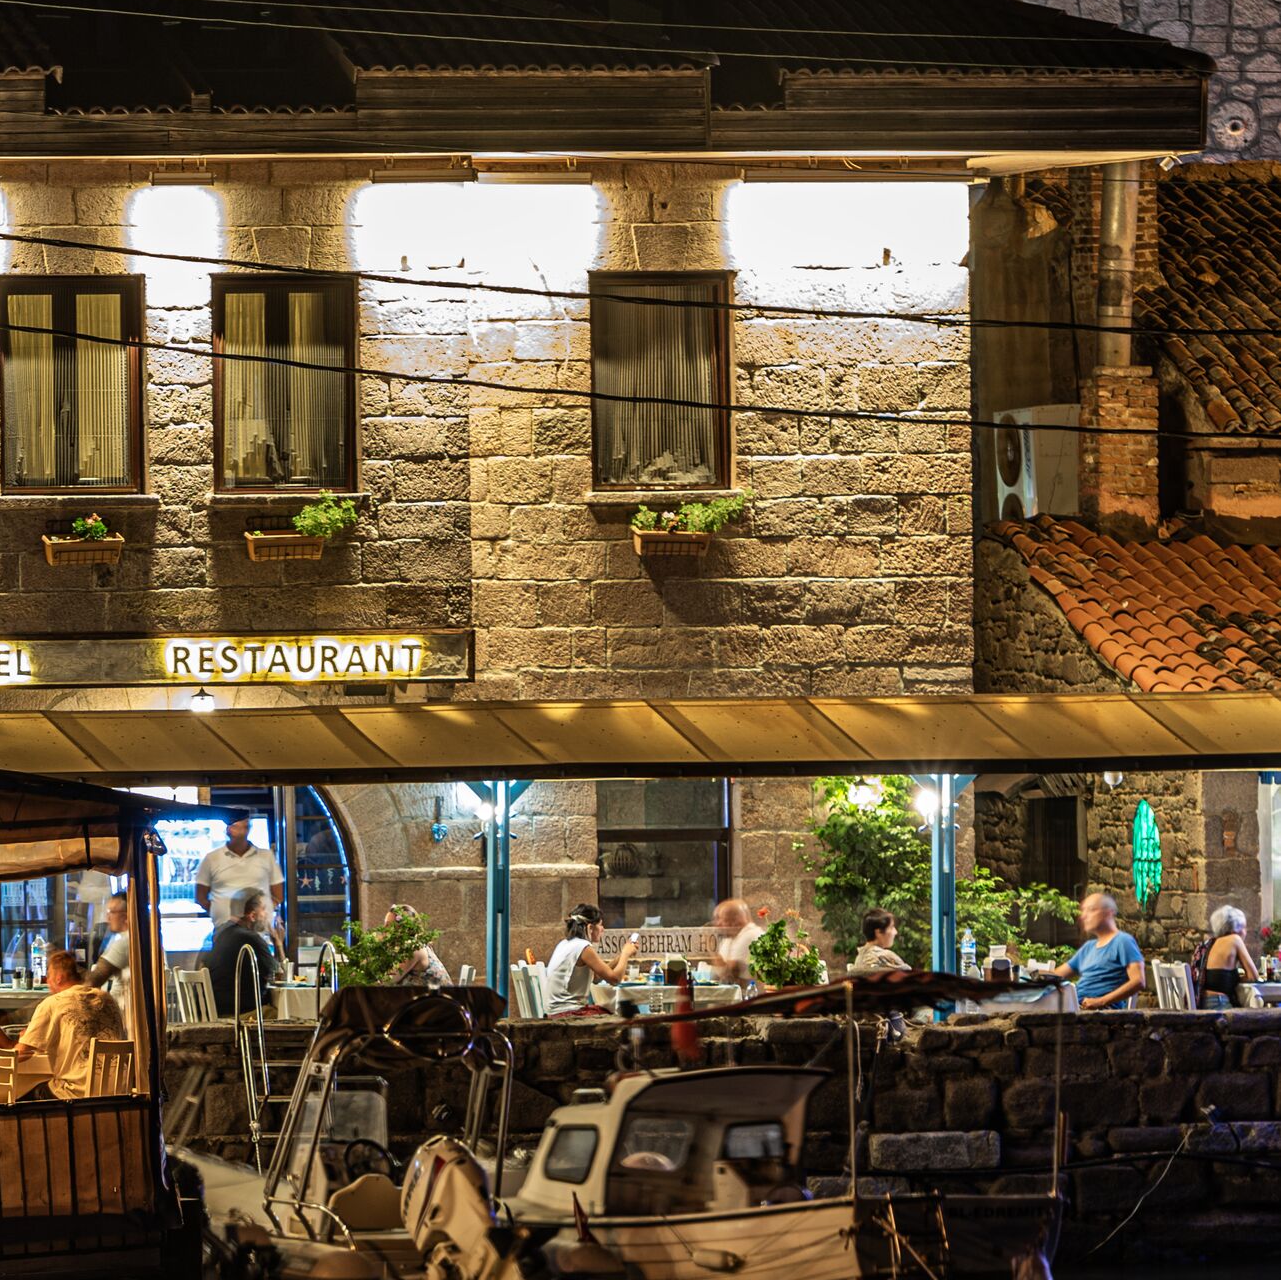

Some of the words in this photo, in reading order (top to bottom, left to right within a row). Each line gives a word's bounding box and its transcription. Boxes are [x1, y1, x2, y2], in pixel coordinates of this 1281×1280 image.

[172, 644, 423, 675] RESTAURANT
[597, 934, 631, 954] ASSO
[641, 933, 692, 953] BEHRAM
